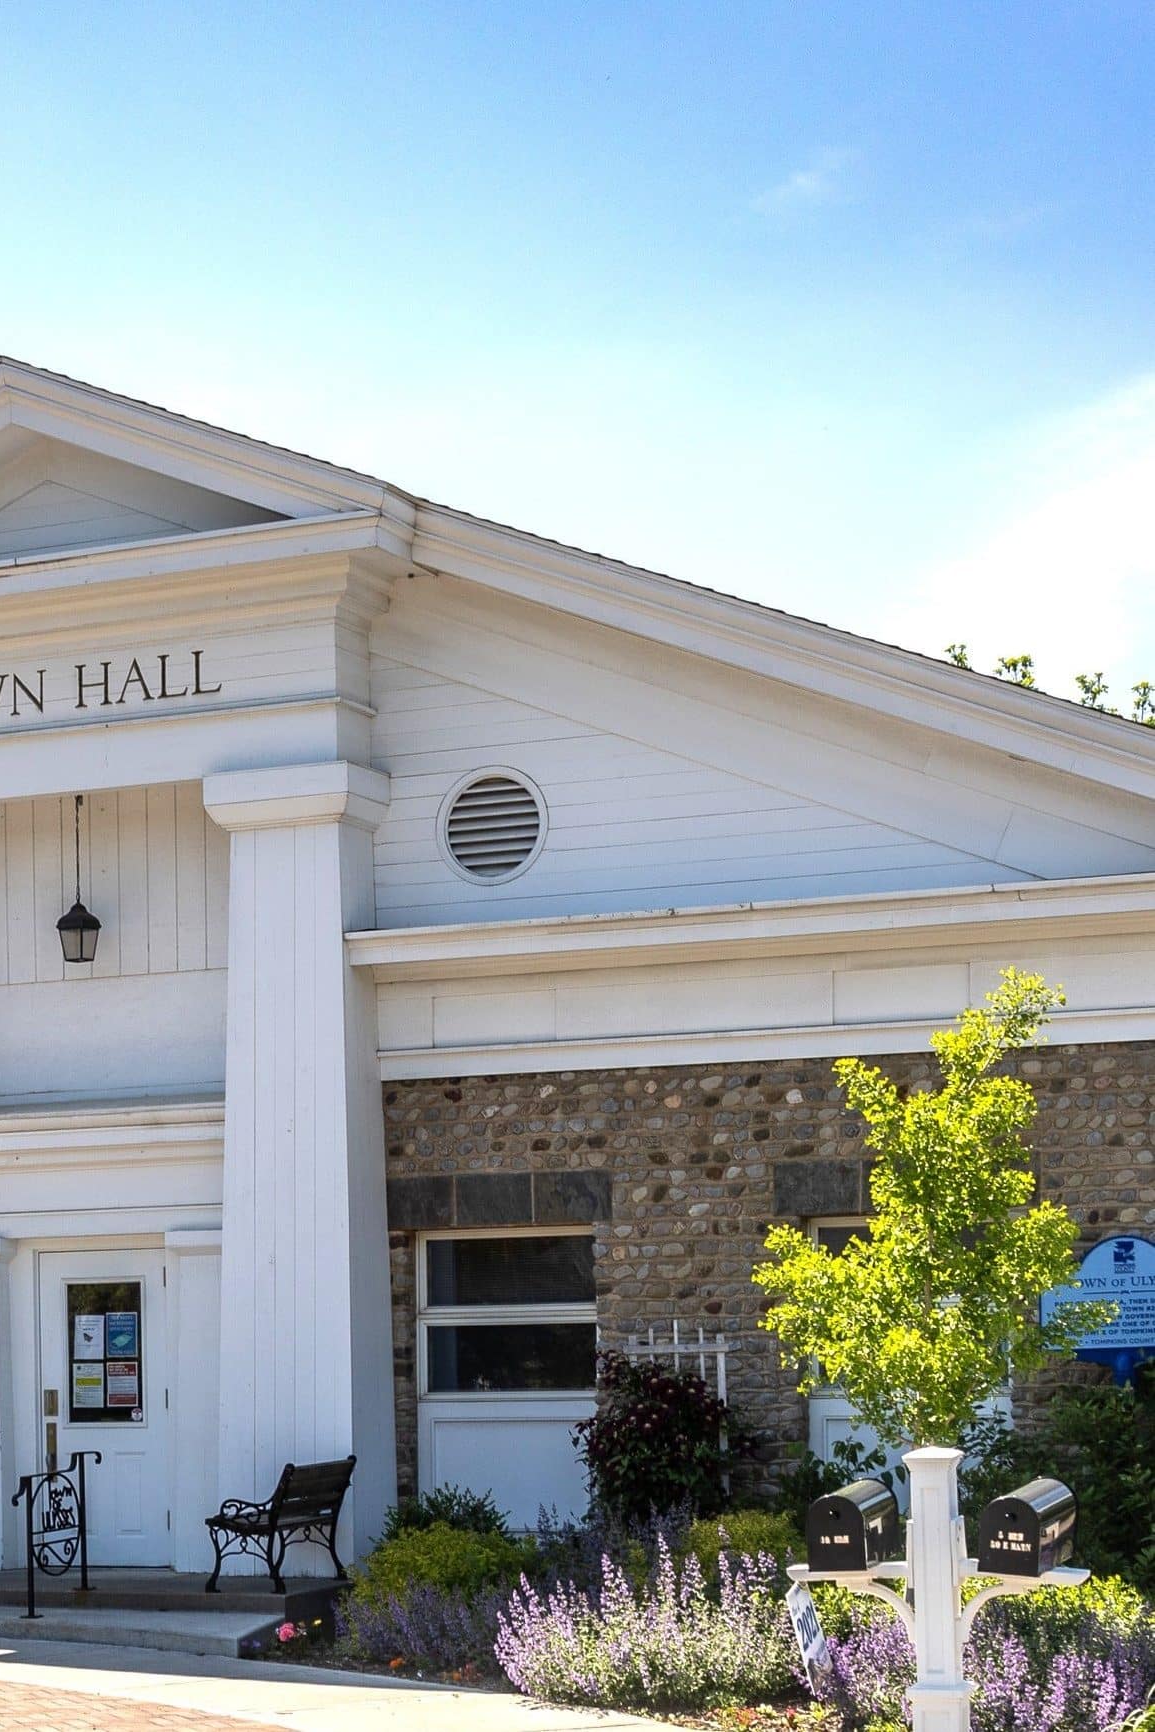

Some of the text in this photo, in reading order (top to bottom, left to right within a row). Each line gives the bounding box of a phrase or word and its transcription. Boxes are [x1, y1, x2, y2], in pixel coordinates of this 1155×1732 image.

[74, 650, 222, 709] HALL
[1069, 1277, 1107, 1289] OWN
[1111, 1278, 1126, 1287] OF
